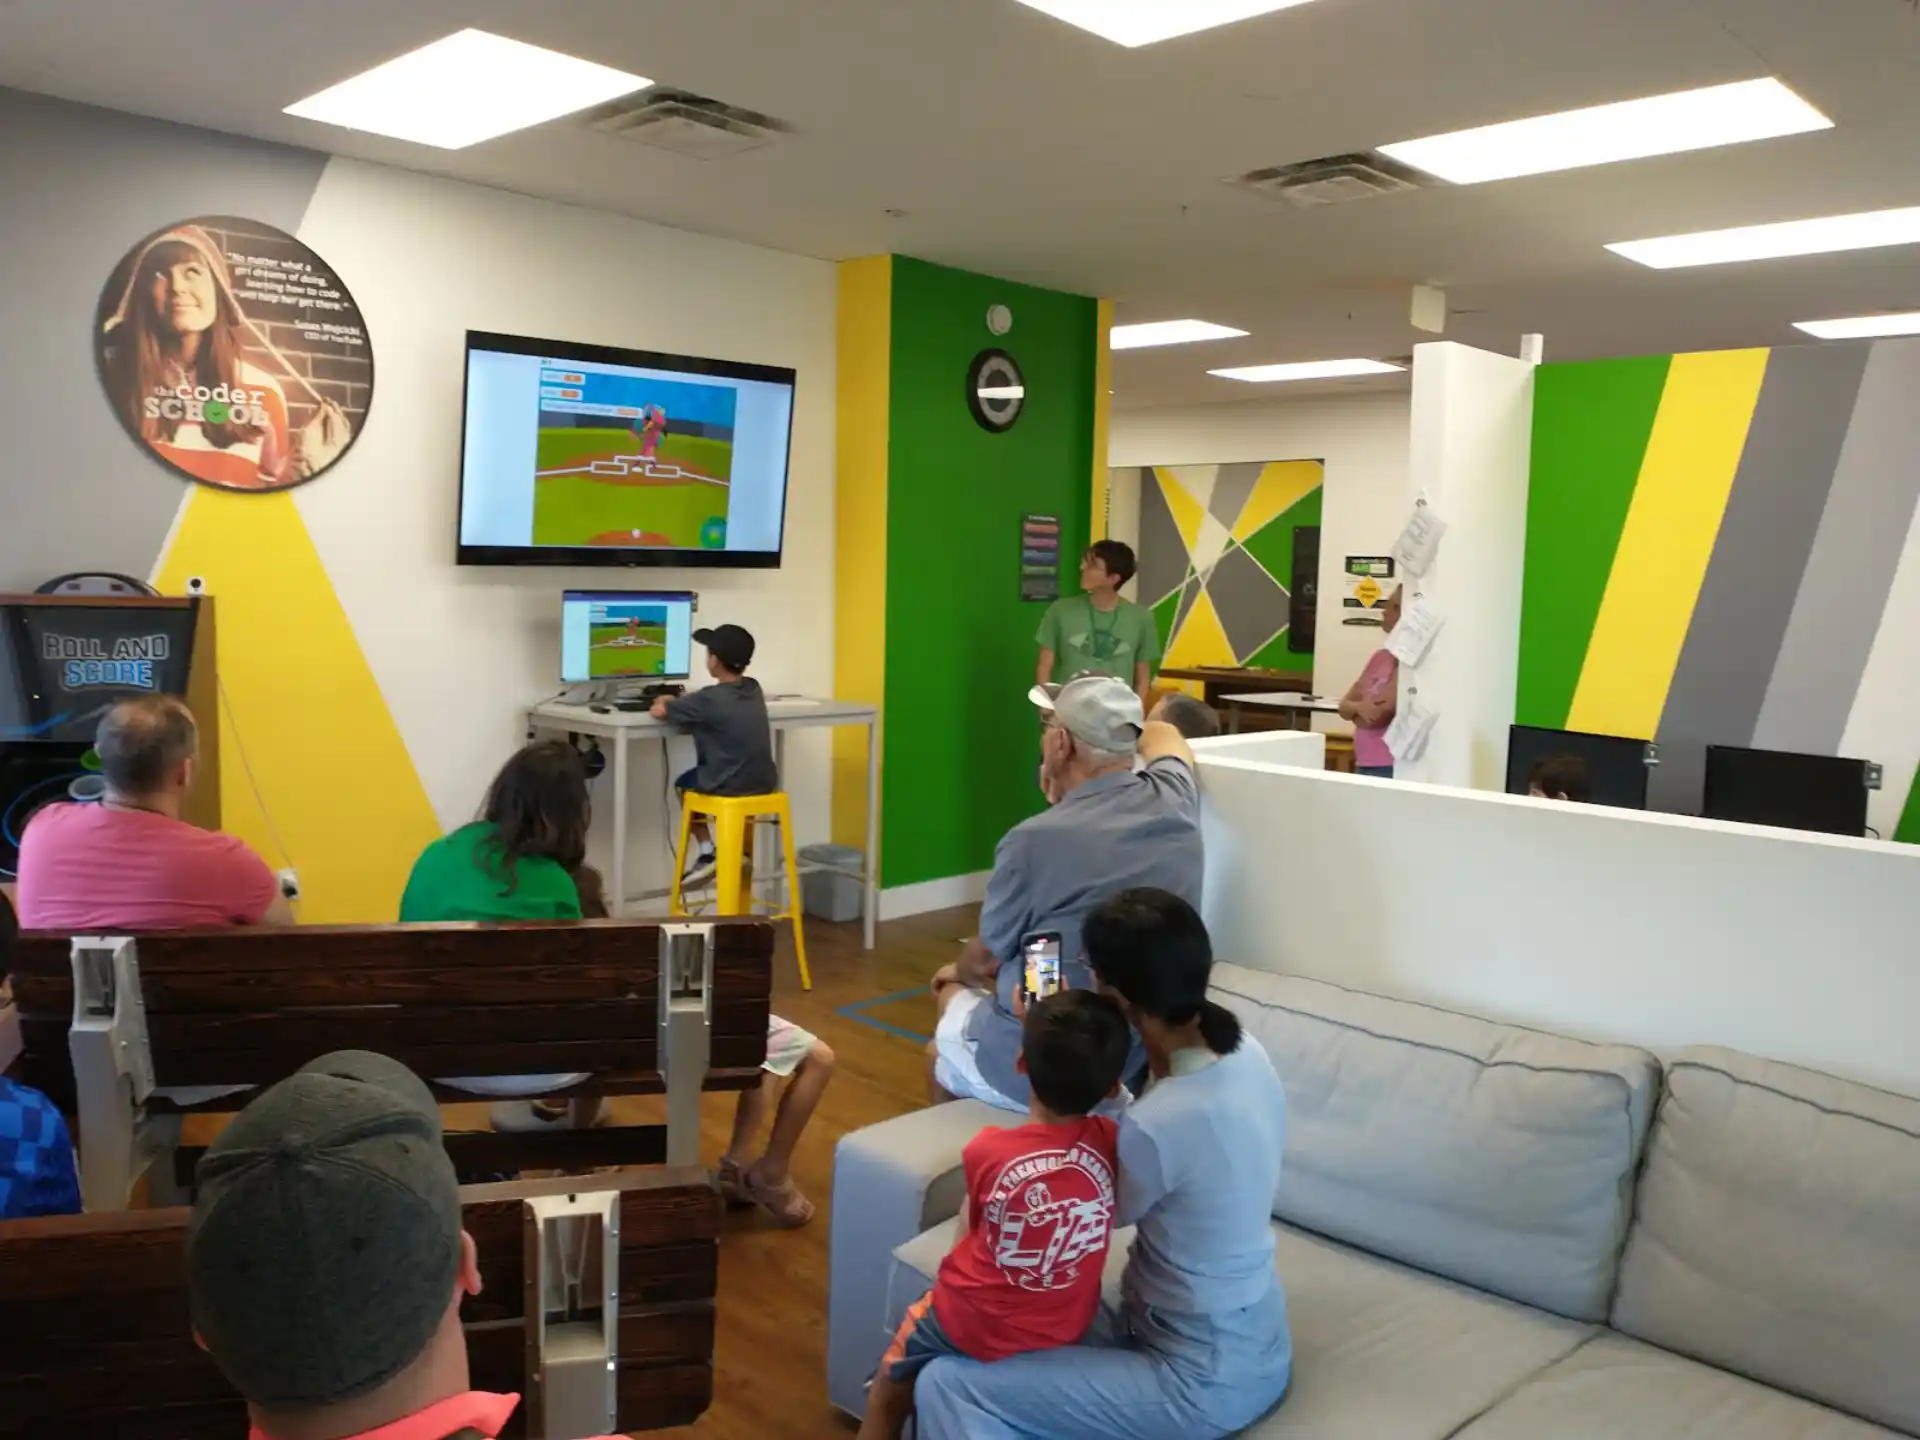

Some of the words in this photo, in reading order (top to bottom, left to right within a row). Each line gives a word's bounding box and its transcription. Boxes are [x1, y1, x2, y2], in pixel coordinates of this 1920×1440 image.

[252, 267, 287, 281] dreams
[287, 272, 300, 281] of
[280, 260, 304, 271] what
[304, 264, 312, 272] a
[245, 277, 284, 294] learning
[285, 283, 306, 294] how
[306, 287, 318, 296] to
[318, 289, 341, 299] code
[258, 291, 281, 304] help
[281, 295, 299, 304] her
[298, 298, 314, 308] get
[42, 632, 108, 659] ROLL
[112, 634, 170, 659] AND
[65, 660, 153, 688] SCORE
